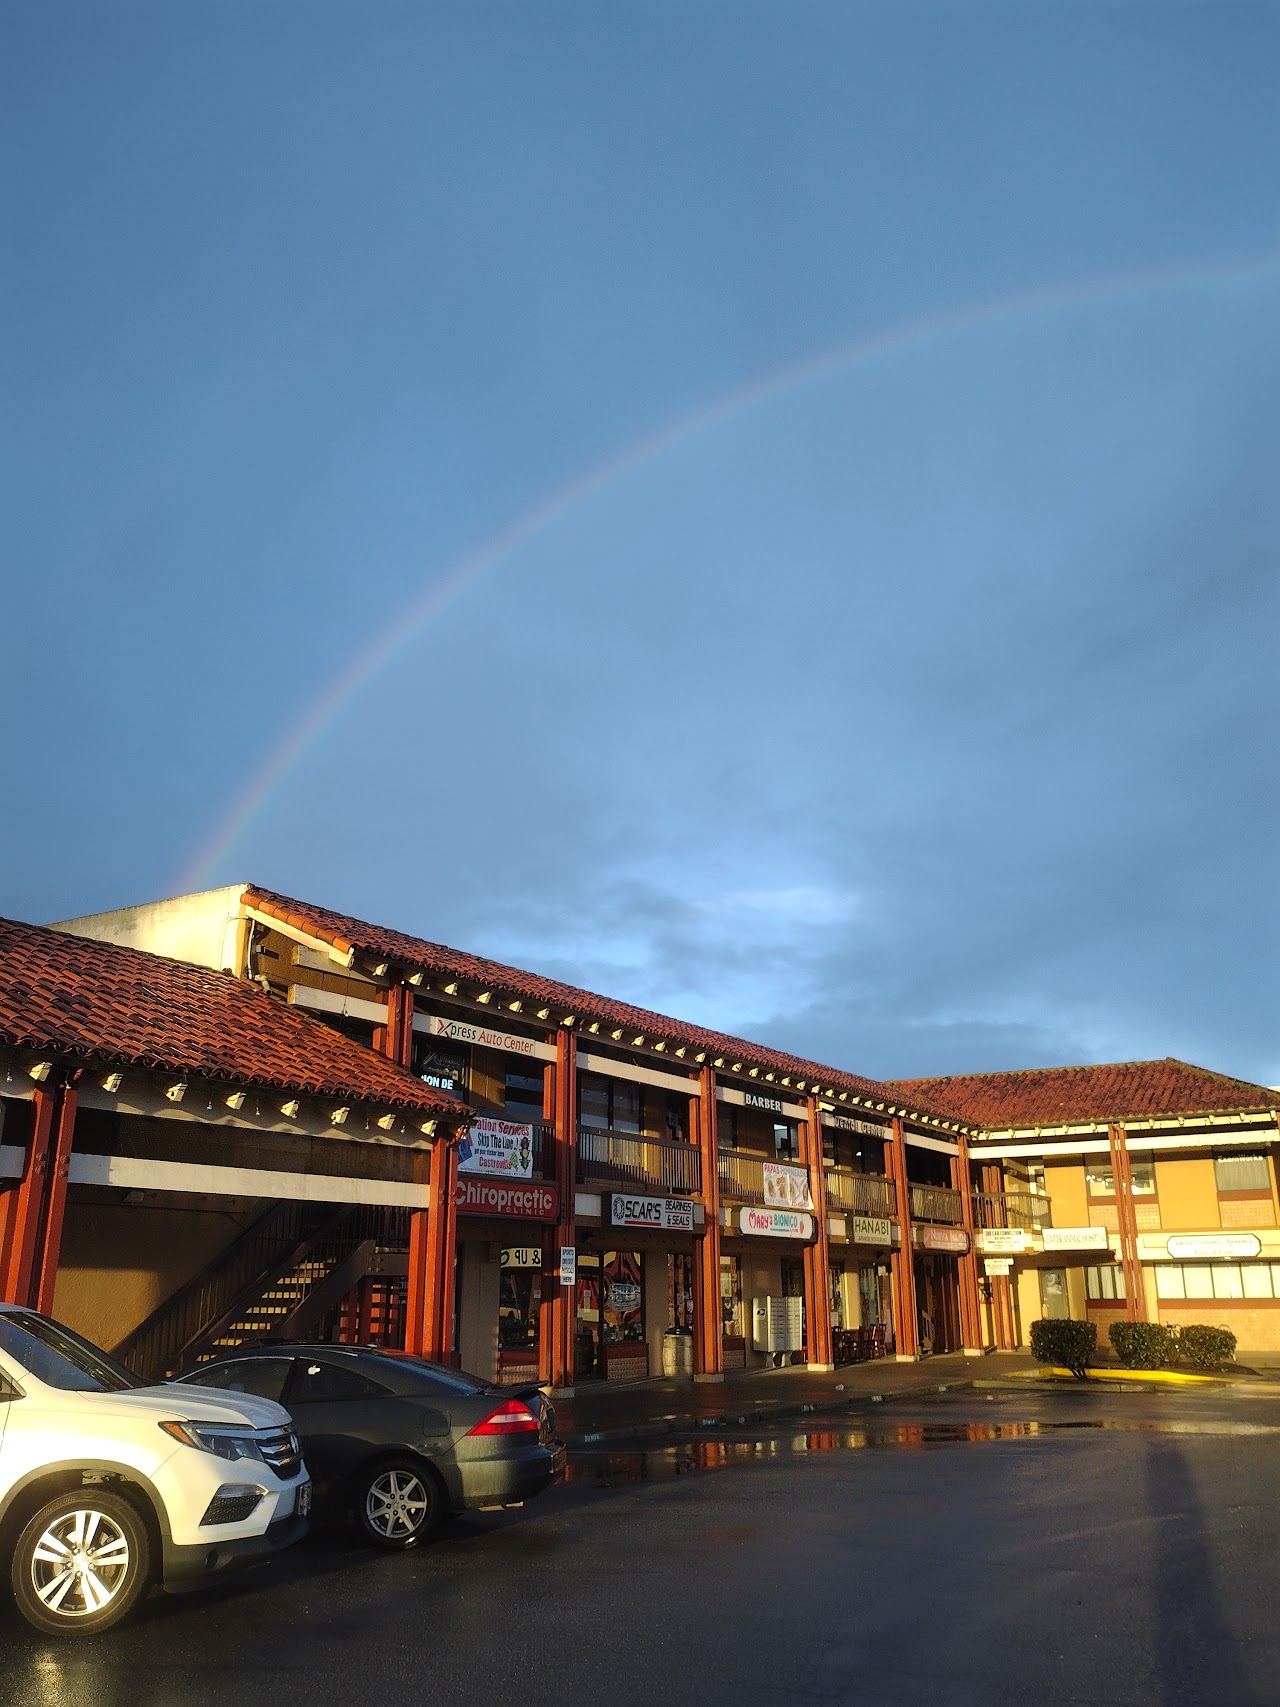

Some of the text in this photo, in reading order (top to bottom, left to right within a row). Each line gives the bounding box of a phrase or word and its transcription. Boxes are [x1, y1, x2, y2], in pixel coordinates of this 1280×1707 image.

[437, 1018, 533, 1053] Xpress Auto Center
[441, 1079, 454, 1090] DE
[745, 1093, 781, 1112] BARBER
[498, 1121, 530, 1137] Services
[478, 1132, 489, 1148] Skip
[491, 1133, 501, 1149] The
[764, 1163, 780, 1175] PAPAS
[456, 1180, 553, 1211] Chiropractic
[506, 1206, 545, 1216] CLINIC
[613, 1196, 661, 1220] OSCAR'S
[665, 1199, 692, 1212] BEARINGS
[672, 1215, 690, 1226] SEALS
[773, 1213, 798, 1228] BIONICO
[855, 1219, 889, 1235] HANABI
